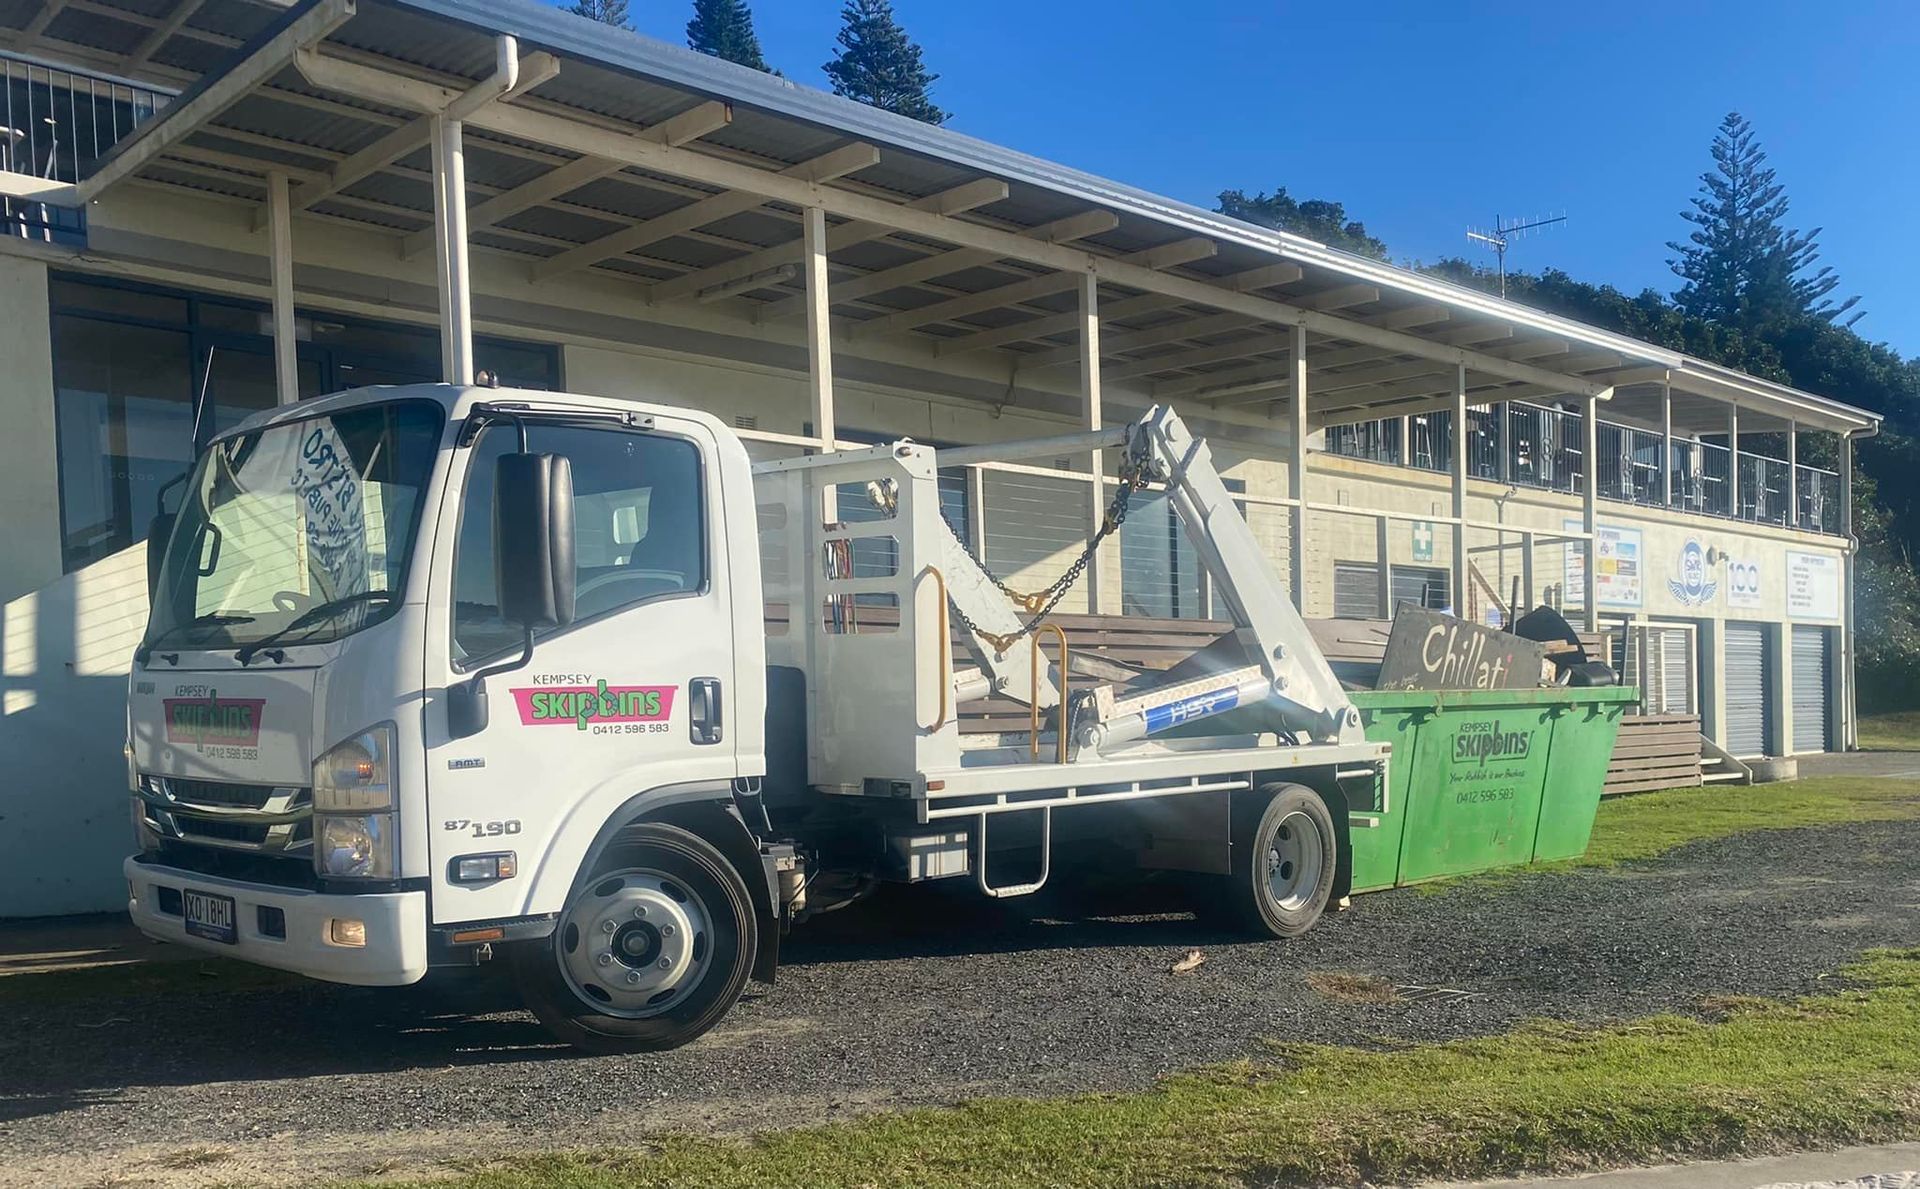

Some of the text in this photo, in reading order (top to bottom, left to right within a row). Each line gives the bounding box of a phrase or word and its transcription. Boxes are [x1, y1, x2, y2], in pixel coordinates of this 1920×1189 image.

[532, 674, 592, 685] KEMPSEY
[175, 685, 209, 697] KEMPSEY
[593, 723, 670, 735] 0412 596 583
[1460, 722, 1491, 732] KEMPSEY
[455, 759, 480, 768] AMT
[1456, 788, 1514, 804] 0412 596 583
[444, 819, 521, 838] 87 190
